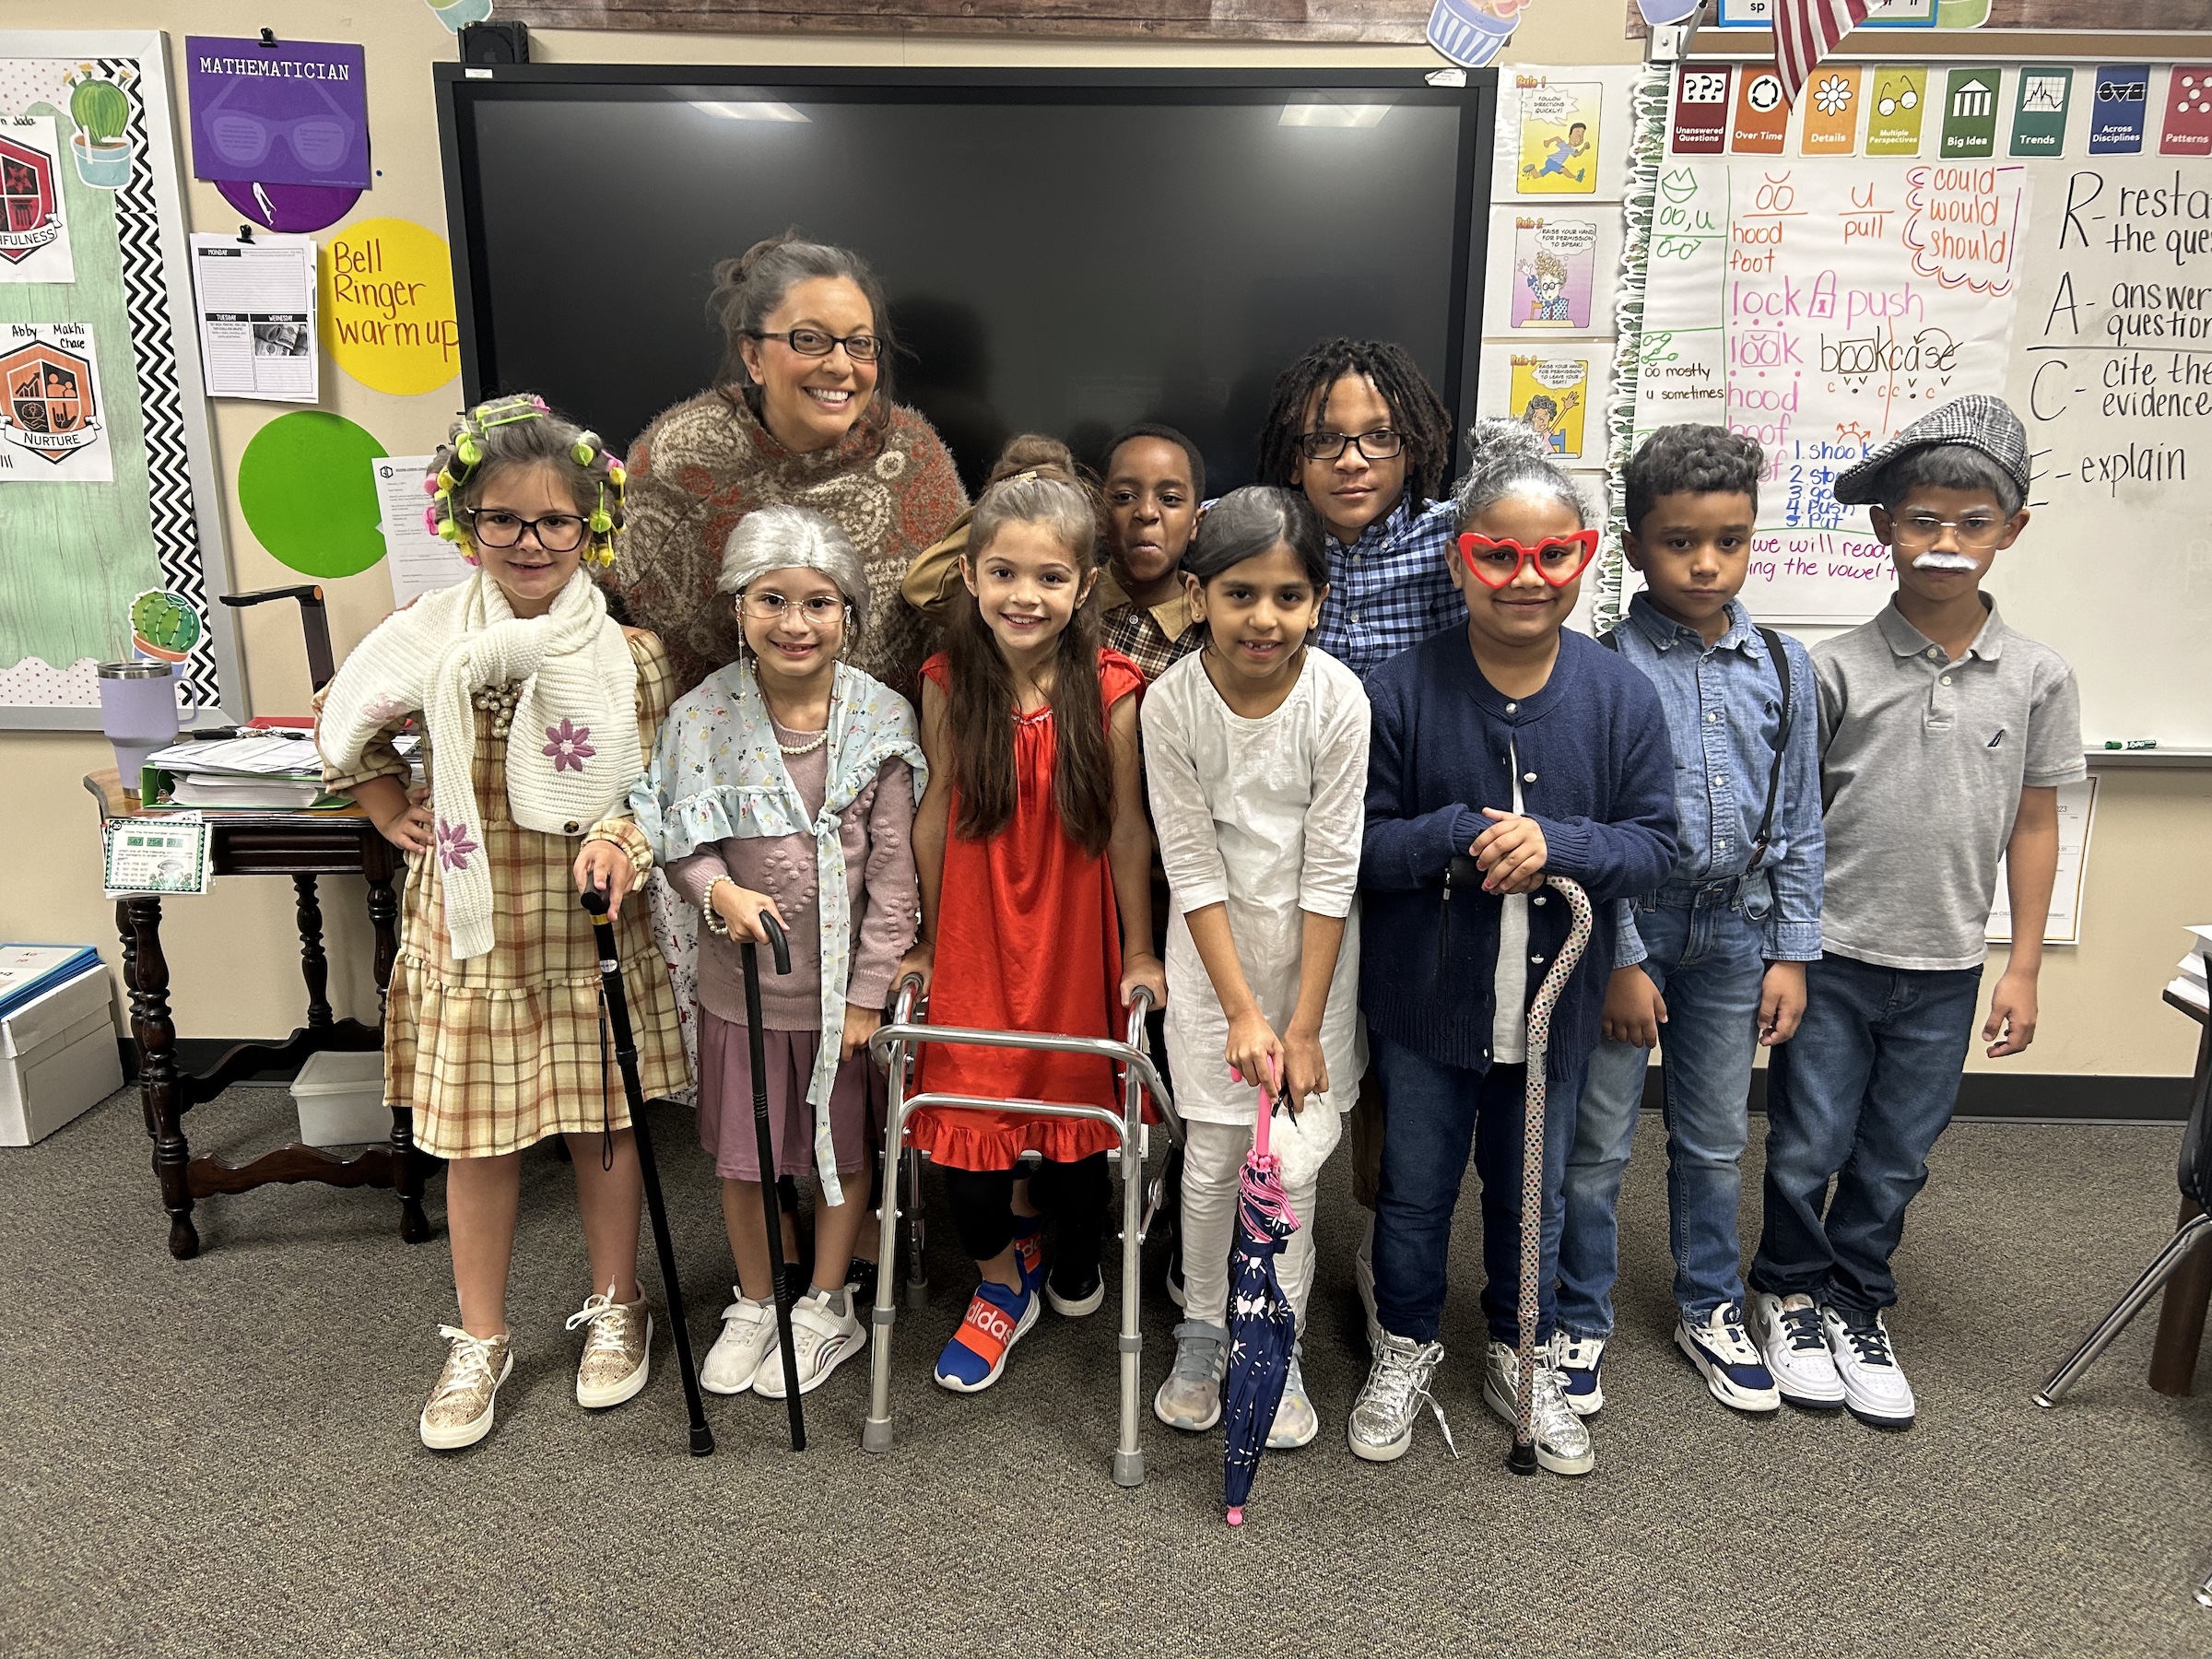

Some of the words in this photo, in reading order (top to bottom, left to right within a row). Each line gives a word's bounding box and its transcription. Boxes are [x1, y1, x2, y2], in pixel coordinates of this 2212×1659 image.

[199, 57, 349, 80] MATHEMATICIAN
[1516, 75, 1538, 88] Rule
[1541, 76, 1547, 88] 1
[13, 116, 36, 126] Jada
[1676, 126, 1724, 135] Unanswered
[2102, 125, 2133, 134] Across
[1678, 134, 1720, 142] Questions
[1735, 131, 1759, 140] Over
[1760, 131, 1783, 141] Time
[1810, 133, 1847, 143] Details
[1869, 136, 1918, 145] Perspectives
[1879, 129, 1910, 137] Multiple
[1947, 135, 1964, 148] Big
[1966, 136, 1988, 146] Idea
[2019, 135, 2055, 145] Trends
[2092, 134, 2140, 143] Disciplines
[2165, 134, 2209, 144] Patterns
[1935, 167, 1994, 194] could
[1852, 182, 1874, 208] u
[2120, 170, 2212, 219] resta
[1930, 194, 1999, 227] would
[1516, 218, 1535, 229] Rule
[1536, 218, 1543, 229] 2
[1732, 220, 1783, 244] hood
[1844, 214, 1883, 244] pull
[1929, 227, 2006, 264] should
[2105, 223, 2157, 253] the
[335, 238, 382, 274] Bell
[1729, 248, 1776, 273] foot
[334, 274, 427, 320] Ringer
[1732, 276, 1801, 316] lock
[1847, 282, 1923, 330] push
[2112, 282, 2212, 312] answer
[12, 324, 38, 340] Abby
[53, 323, 85, 335] Makhi
[60, 338, 85, 349] Chase
[1731, 332, 1804, 364] look
[1821, 326, 1958, 371] bookcase
[1511, 355, 1529, 366] Rule
[1665, 362, 1711, 381] mostly
[2103, 352, 2157, 388] cite
[2168, 353, 2212, 385] the
[1646, 390, 1653, 400] u
[1662, 385, 1724, 400] sometimes
[1727, 381, 1798, 412] hood
[2102, 387, 2212, 417] evidence
[24, 432, 80, 446] NURTURE
[2082, 442, 2185, 498] explain
[1753, 538, 1780, 552] we
[1790, 533, 1832, 554] will
[1784, 557, 1818, 575] the
[1829, 563, 1879, 581] vowel
